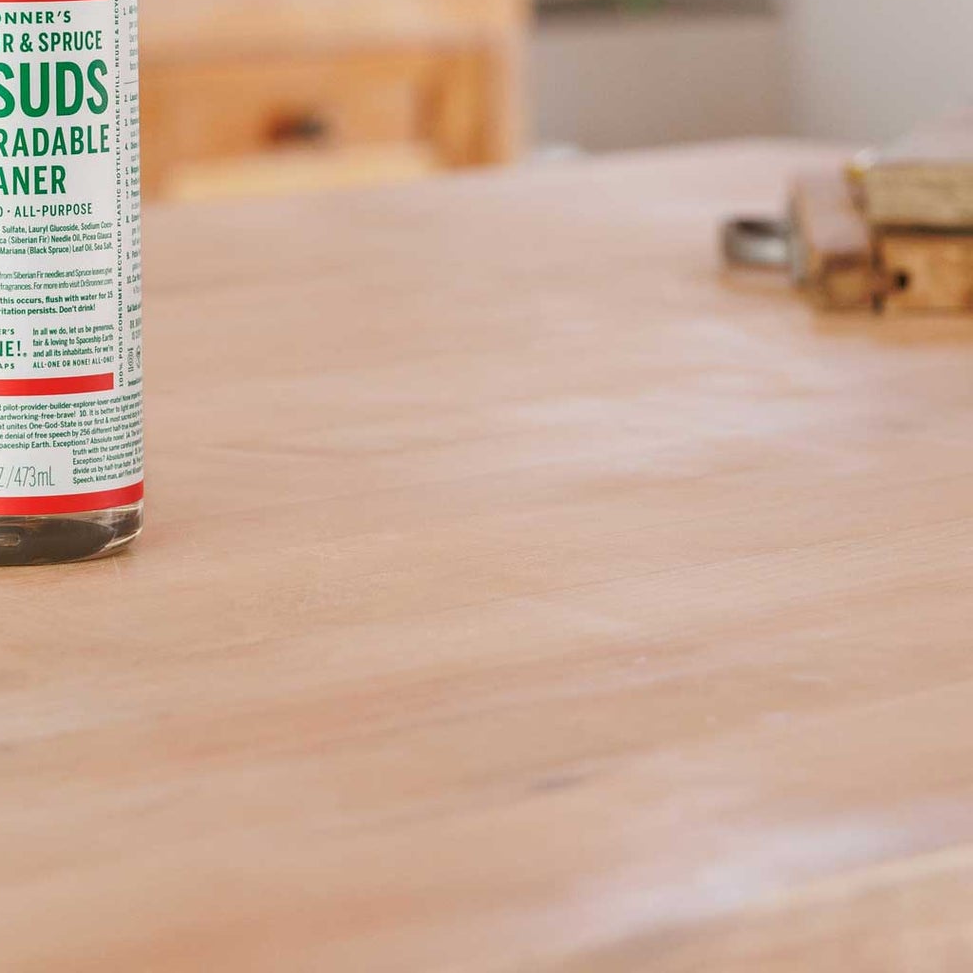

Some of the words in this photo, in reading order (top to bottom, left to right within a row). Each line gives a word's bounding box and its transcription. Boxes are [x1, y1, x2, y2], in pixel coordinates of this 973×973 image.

[20, 33, 33, 53] &
[39, 30, 102, 52] SPRUCE
[15, 203, 92, 217] ALL-PURPOSE
[29, 225, 48, 234] Lauryl
[8, 235, 38, 244] (Siberian
[39, 235, 50, 243] Fir)
[51, 234, 71, 242] Needle
[83, 233, 96, 241] Picea
[97, 232, 112, 240] Glauca
[27, 246, 46, 255] (Black
[48, 245, 71, 254] Spruce)
[73, 244, 83, 252] Leaf
[14, 270, 36, 279] Siberian
[28, 307, 58, 315] persists.
[60, 305, 77, 313] Don't
[51, 338, 67, 347] loving
[76, 336, 101, 345] Spaceship
[102, 334, 113, 342] Earth
[33, 349, 44, 357] and
[92, 356, 114, 364] ALL-ONE!
[29, 421, 76, 430] One-God-State
[49, 430, 70, 439] speech
[91, 426, 111, 435] different
[31, 440, 51, 448] Earth.
[53, 438, 89, 448] Exceptions?
